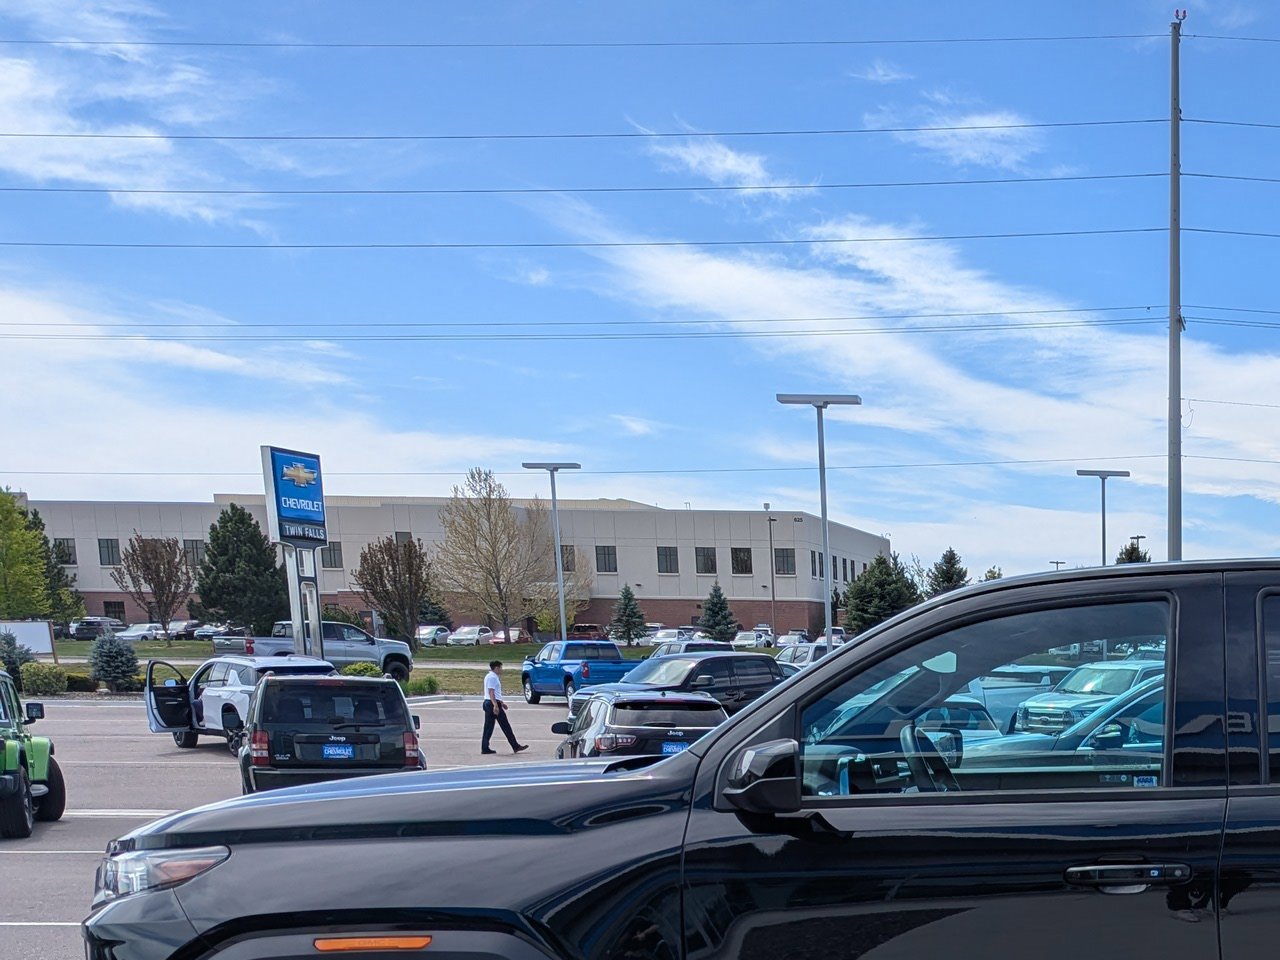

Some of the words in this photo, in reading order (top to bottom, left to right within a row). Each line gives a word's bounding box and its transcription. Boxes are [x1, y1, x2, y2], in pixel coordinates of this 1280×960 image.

[281, 497, 322, 511] CHEVROLET
[285, 525, 303, 537] TWIN
[305, 527, 325, 539] FALLS
